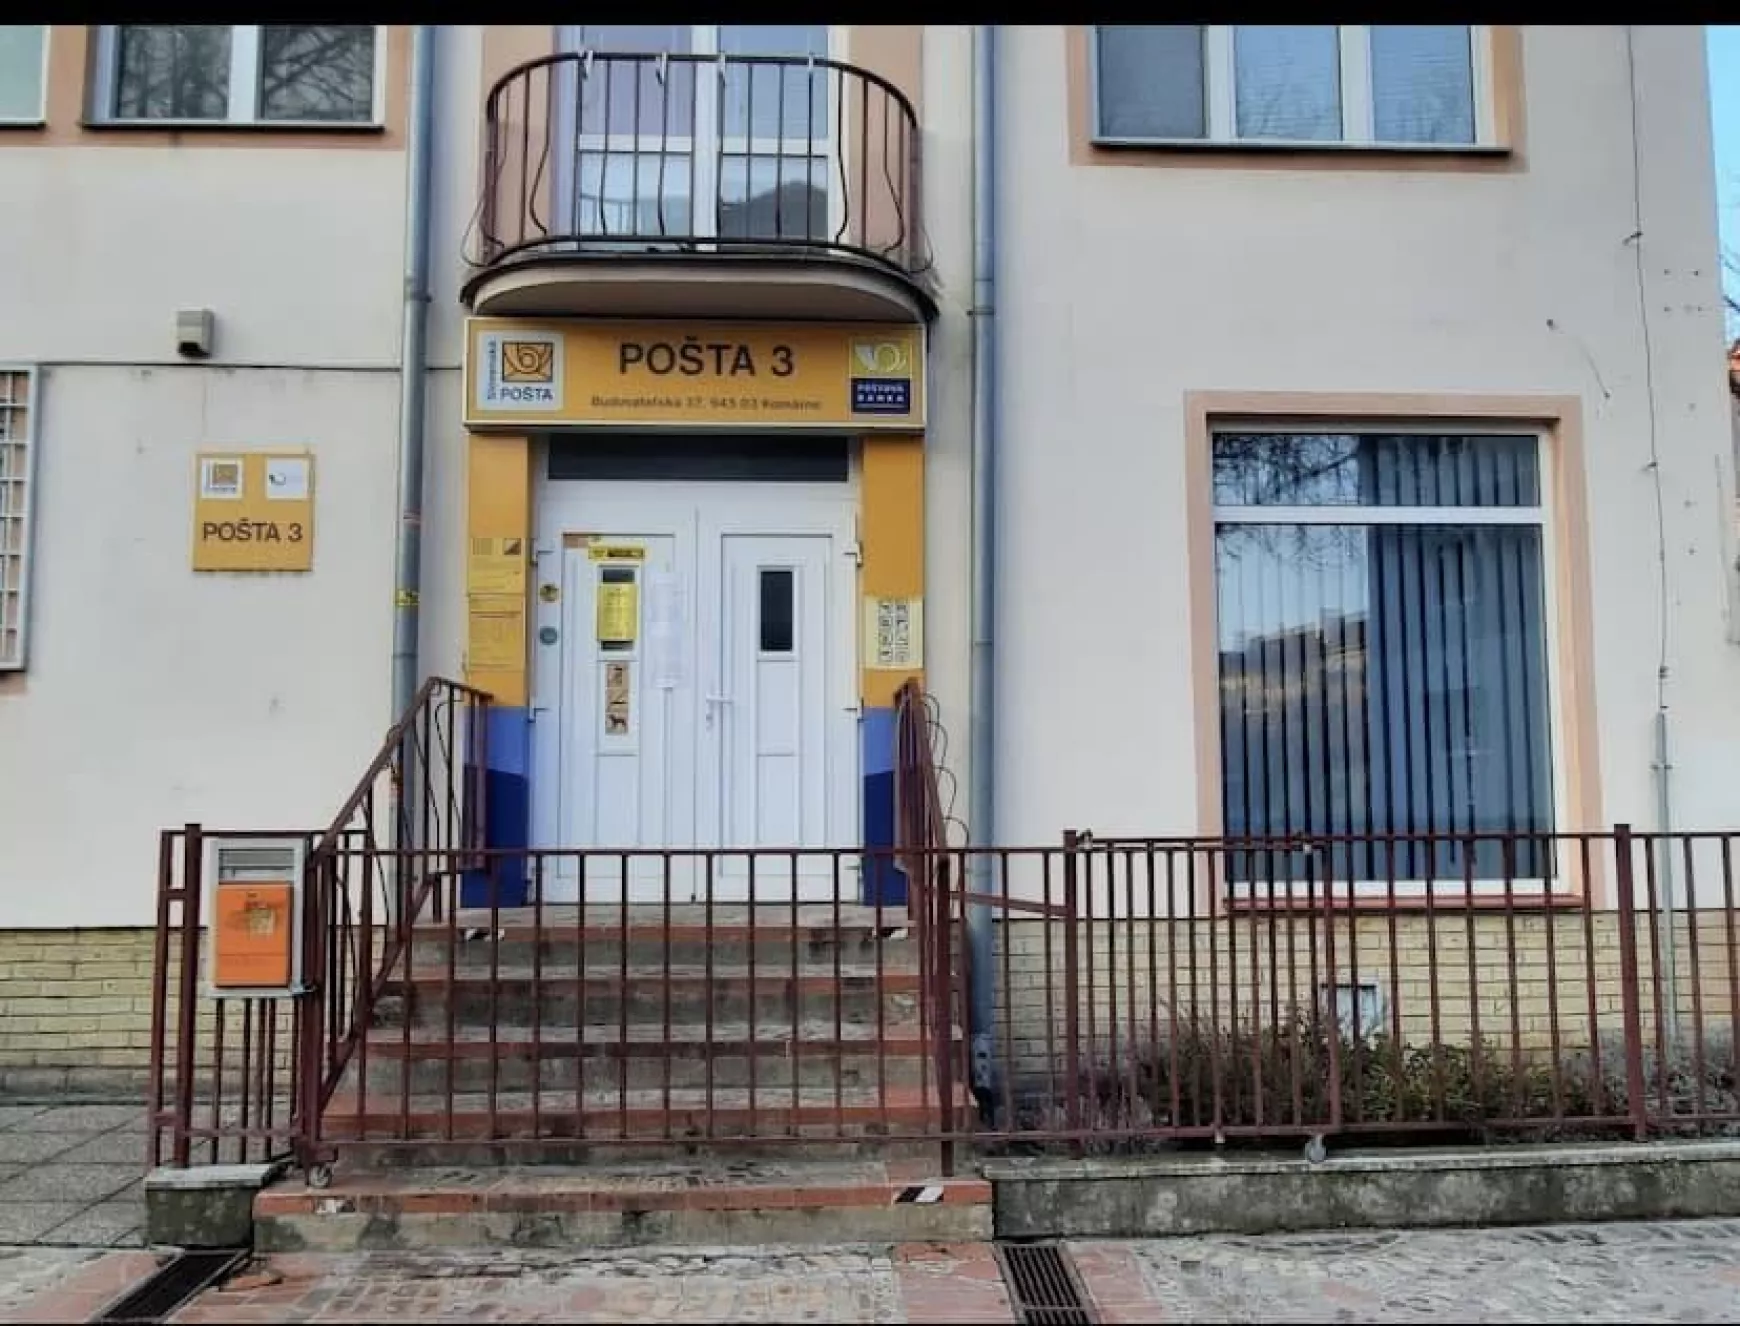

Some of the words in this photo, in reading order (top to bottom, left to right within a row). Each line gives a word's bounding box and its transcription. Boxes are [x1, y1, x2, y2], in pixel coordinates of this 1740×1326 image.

[619, 335, 756, 376] POŠTA
[771, 344, 794, 377] 3
[502, 386, 553, 401] POŠTA
[203, 517, 281, 542] POŠTA
[287, 521, 303, 542] 3
